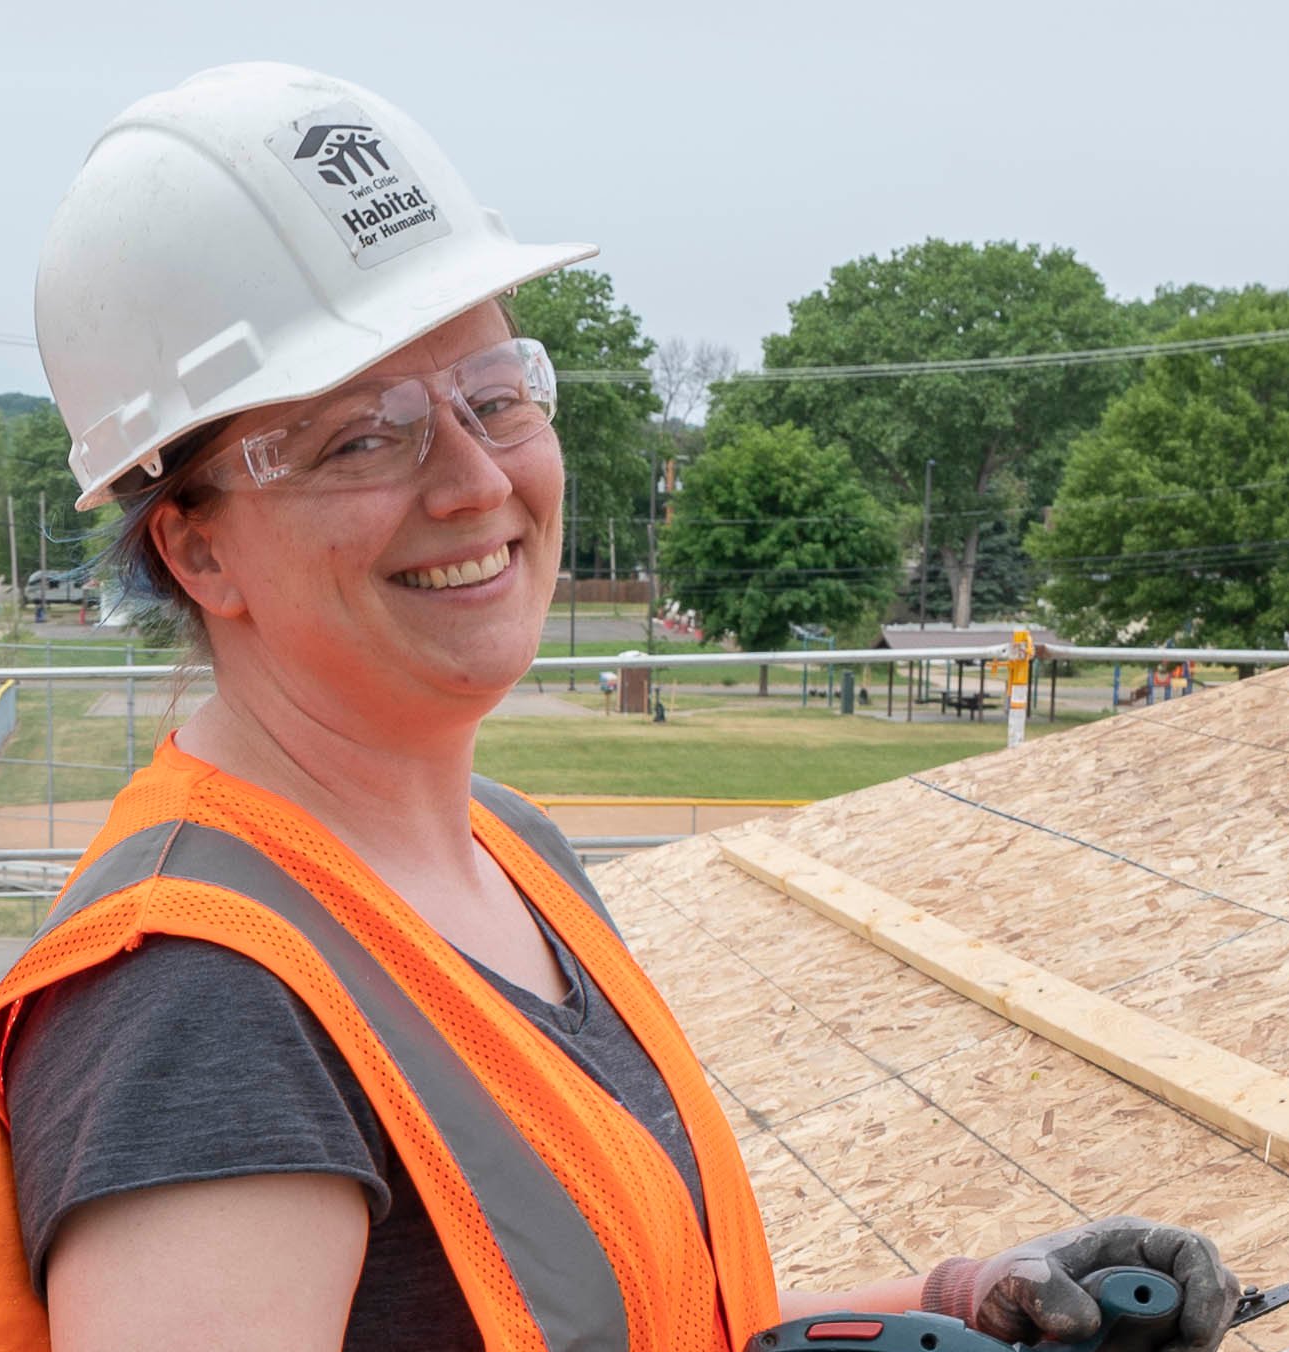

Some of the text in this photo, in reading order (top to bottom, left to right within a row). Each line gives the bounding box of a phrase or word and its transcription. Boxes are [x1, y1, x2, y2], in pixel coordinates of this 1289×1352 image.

[348, 175, 399, 200] Twin Cities
[342, 185, 427, 236] Habitat
[358, 232, 378, 248] for
